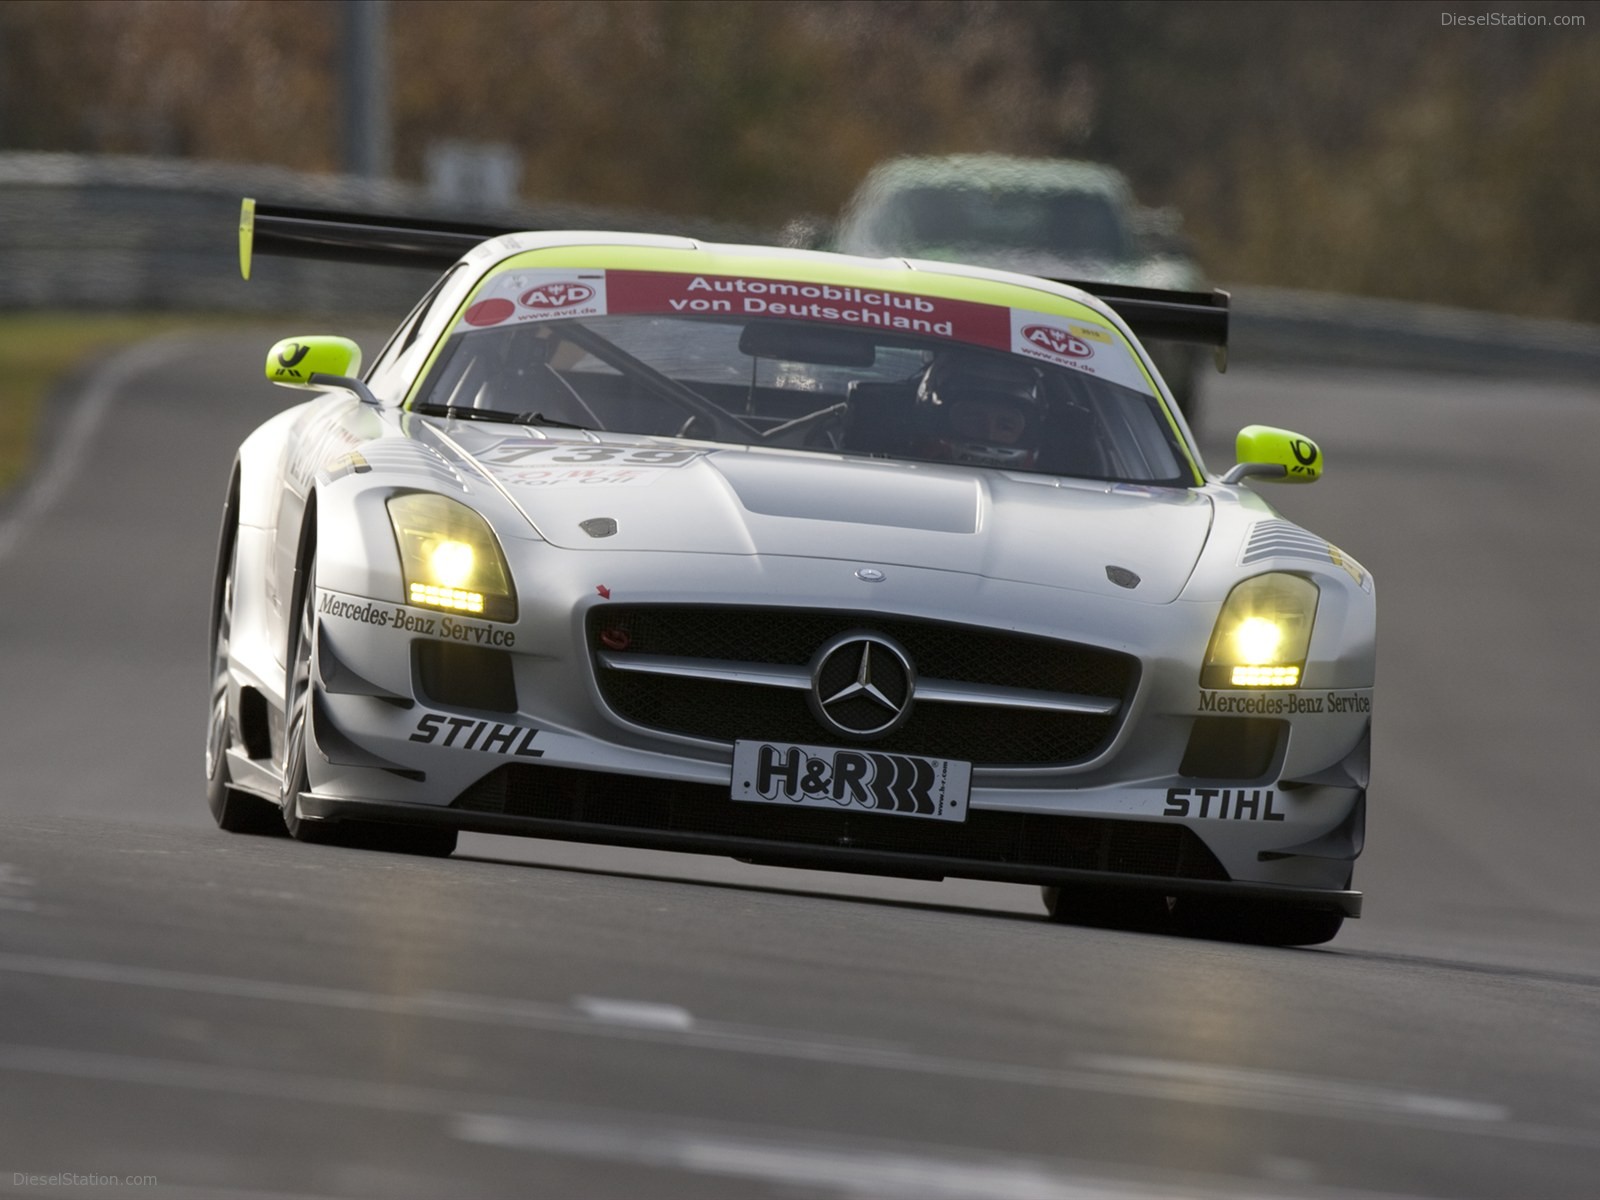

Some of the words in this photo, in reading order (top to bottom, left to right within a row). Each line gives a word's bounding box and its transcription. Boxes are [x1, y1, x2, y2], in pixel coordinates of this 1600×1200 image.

[525, 286, 590, 306] AvD
[687, 276, 935, 313] Automobilclub
[517, 307, 597, 321] www.avd.de
[669, 298, 732, 311] von
[743, 297, 953, 336] Deutschland
[1028, 329, 1088, 355] AvD
[1020, 347, 1096, 373] www.avd.de
[490, 446, 698, 464] 739
[318, 592, 436, 635] Mercedes-Benz
[439, 617, 516, 647] Service
[1197, 690, 1324, 714] Mercedes-Benz
[1327, 691, 1371, 713] Service
[408, 713, 546, 758] STIHL
[1163, 787, 1286, 822] STIHL
